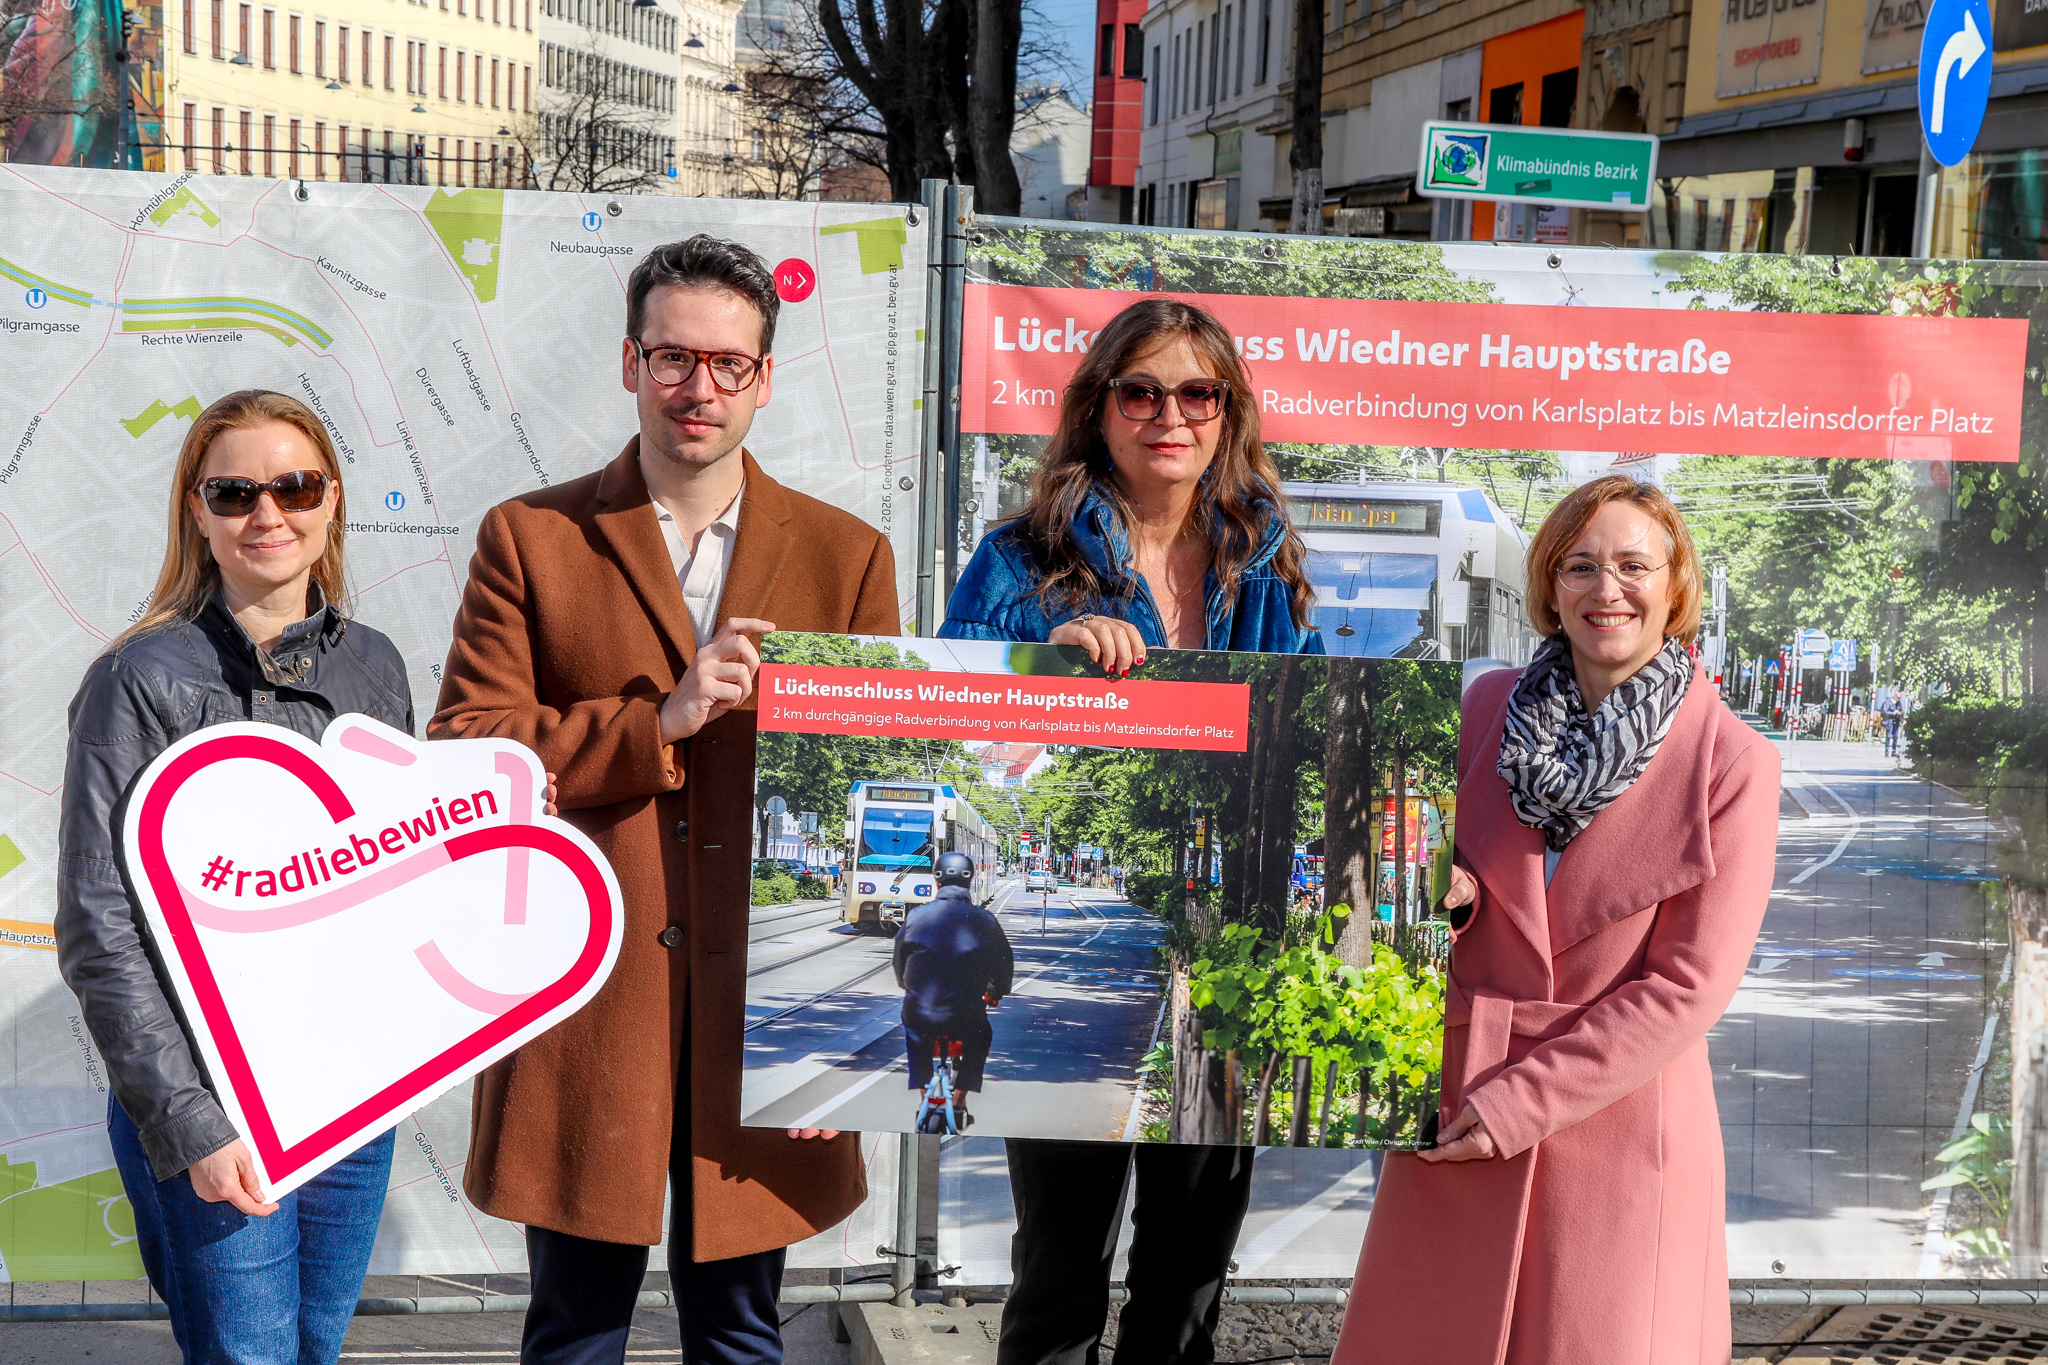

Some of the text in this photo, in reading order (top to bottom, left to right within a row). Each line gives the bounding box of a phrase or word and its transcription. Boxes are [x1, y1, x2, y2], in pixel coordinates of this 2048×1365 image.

[1497, 155, 1638, 181] Klimabündnis Bezirk
[129, 173, 193, 231] Hofmühlgasse
[550, 240, 634, 257] Neubaugasse
[316, 255, 387, 300] Kaunitzgasse
[886, 263, 899, 309] bev.gv.at
[141, 331, 243, 346] Rechte Wienzeile
[1295, 327, 1470, 367] Wiedner
[1480, 333, 1731, 381] Hauptstraße
[415, 367, 455, 428] Dürergasse
[452, 338, 492, 412] Luftbadgasse
[884, 358, 897, 437] data.wien.gv.at,
[297, 371, 356, 464] Hamburgerstraße
[991, 379, 1994, 434] 2 km Radverbindung von Karlsplatz bis Matzleinsdorfer Platz
[0, 414, 42, 484] Pilgramgasse
[396, 420, 433, 505] Linke Wienzeile
[882, 440, 893, 490] Geodaten:
[344, 521, 460, 537] ettenbrückengasse
[774, 677, 1130, 712] Lückenschluss Wiedner Hauptstraße
[772, 707, 1234, 739] 2 km durchgängige Radverbindung von Karlsplatz bis Matzleinsdorfer Platz
[200, 789, 499, 898] #radliebewien
[0, 929, 58, 946] Hauptstra
[67, 1014, 106, 1094] Mayerhofgasse
[414, 1131, 459, 1204] Gußhausstraße
